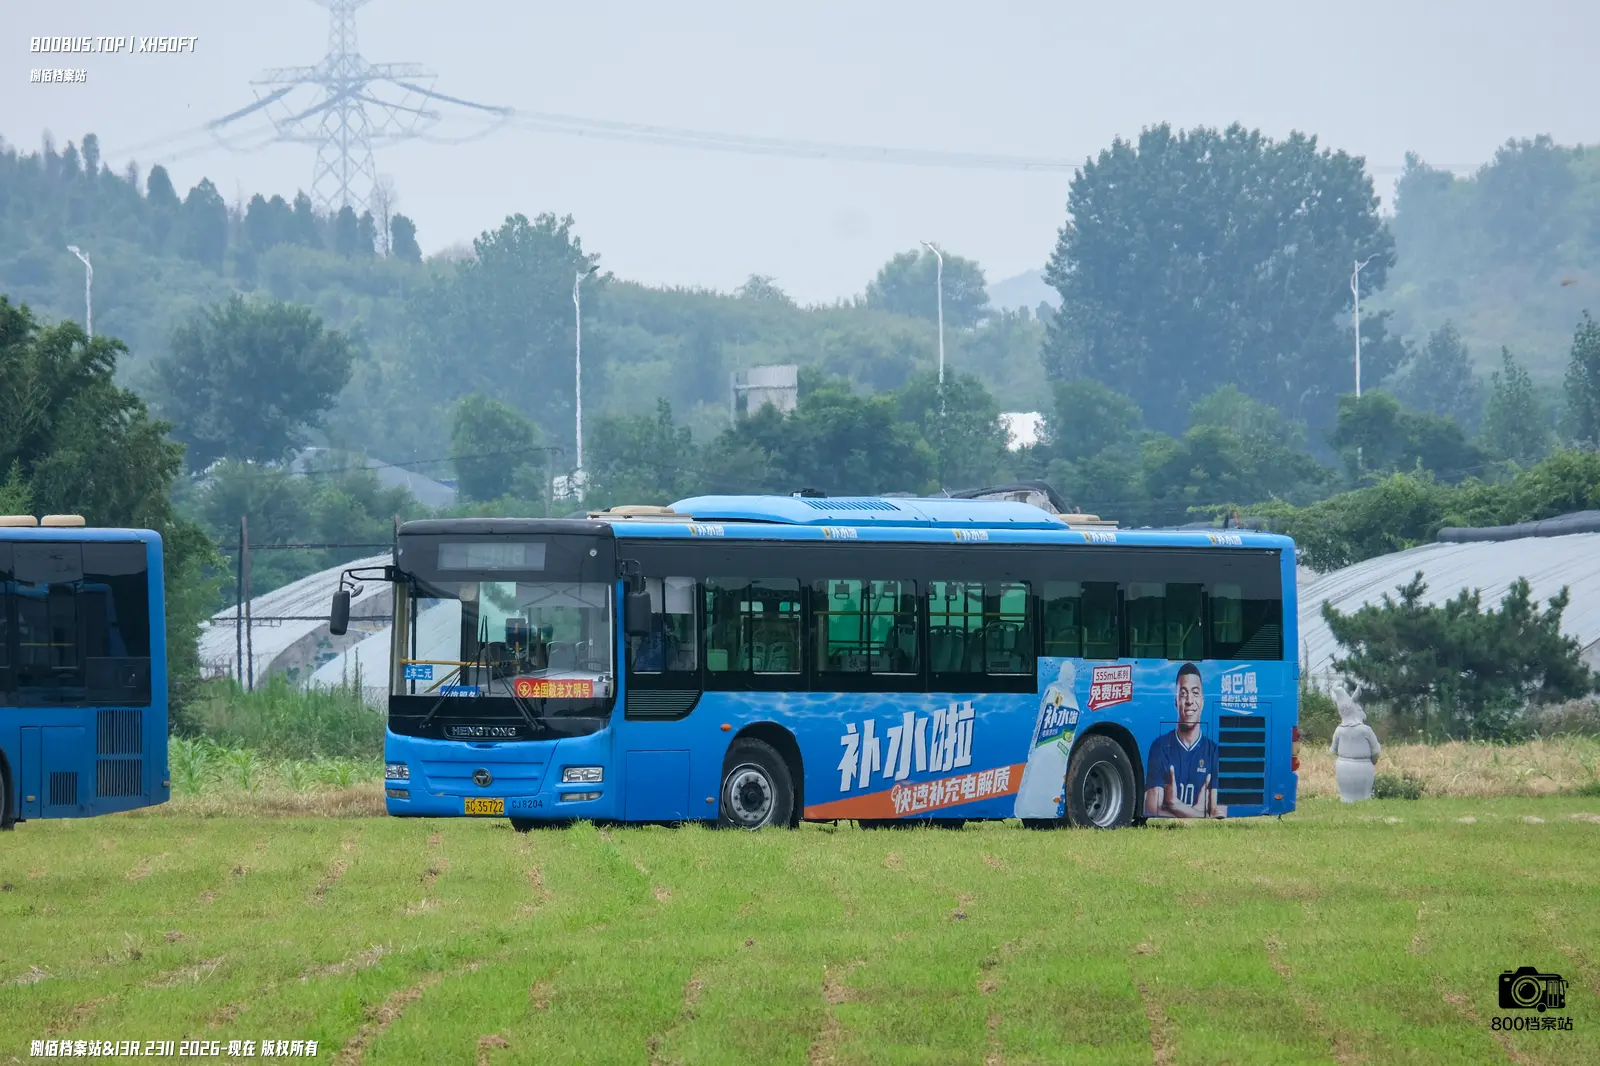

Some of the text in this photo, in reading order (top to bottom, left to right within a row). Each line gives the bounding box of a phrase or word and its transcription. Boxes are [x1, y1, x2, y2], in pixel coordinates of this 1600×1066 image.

[404, 667, 432, 679] 上车二元
[1094, 669, 1129, 681] 555mL系列
[1220, 671, 1258, 695] 姆巴佩
[533, 682, 591, 698] 全国敬老文明号
[1088, 682, 1132, 706] 免费乐享
[1043, 706, 1079, 729] 补水啦
[452, 726, 516, 737] HENGTONG
[837, 701, 975, 792] 补水啦
[894, 766, 1011, 814] 快速补充电解质
[1180, 783, 1195, 807] 10
[512, 800, 543, 809] CJ8204
